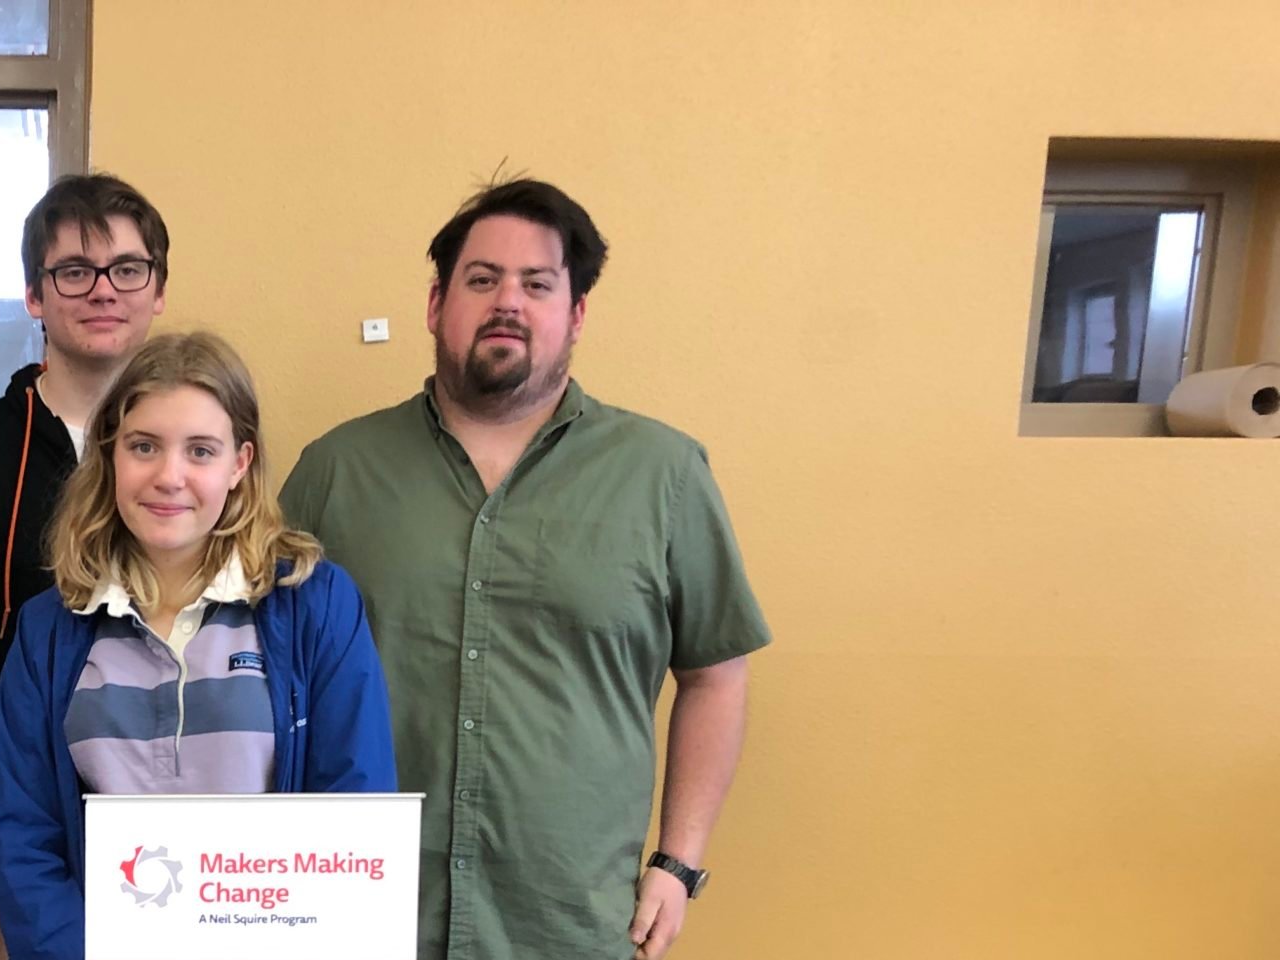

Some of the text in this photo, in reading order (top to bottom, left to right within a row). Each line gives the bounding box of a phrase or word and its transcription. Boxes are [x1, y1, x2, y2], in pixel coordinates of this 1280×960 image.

[200, 852, 385, 881] Makers Making
[199, 881, 289, 910] Change
[199, 914, 317, 926] A Neil Squire Program
